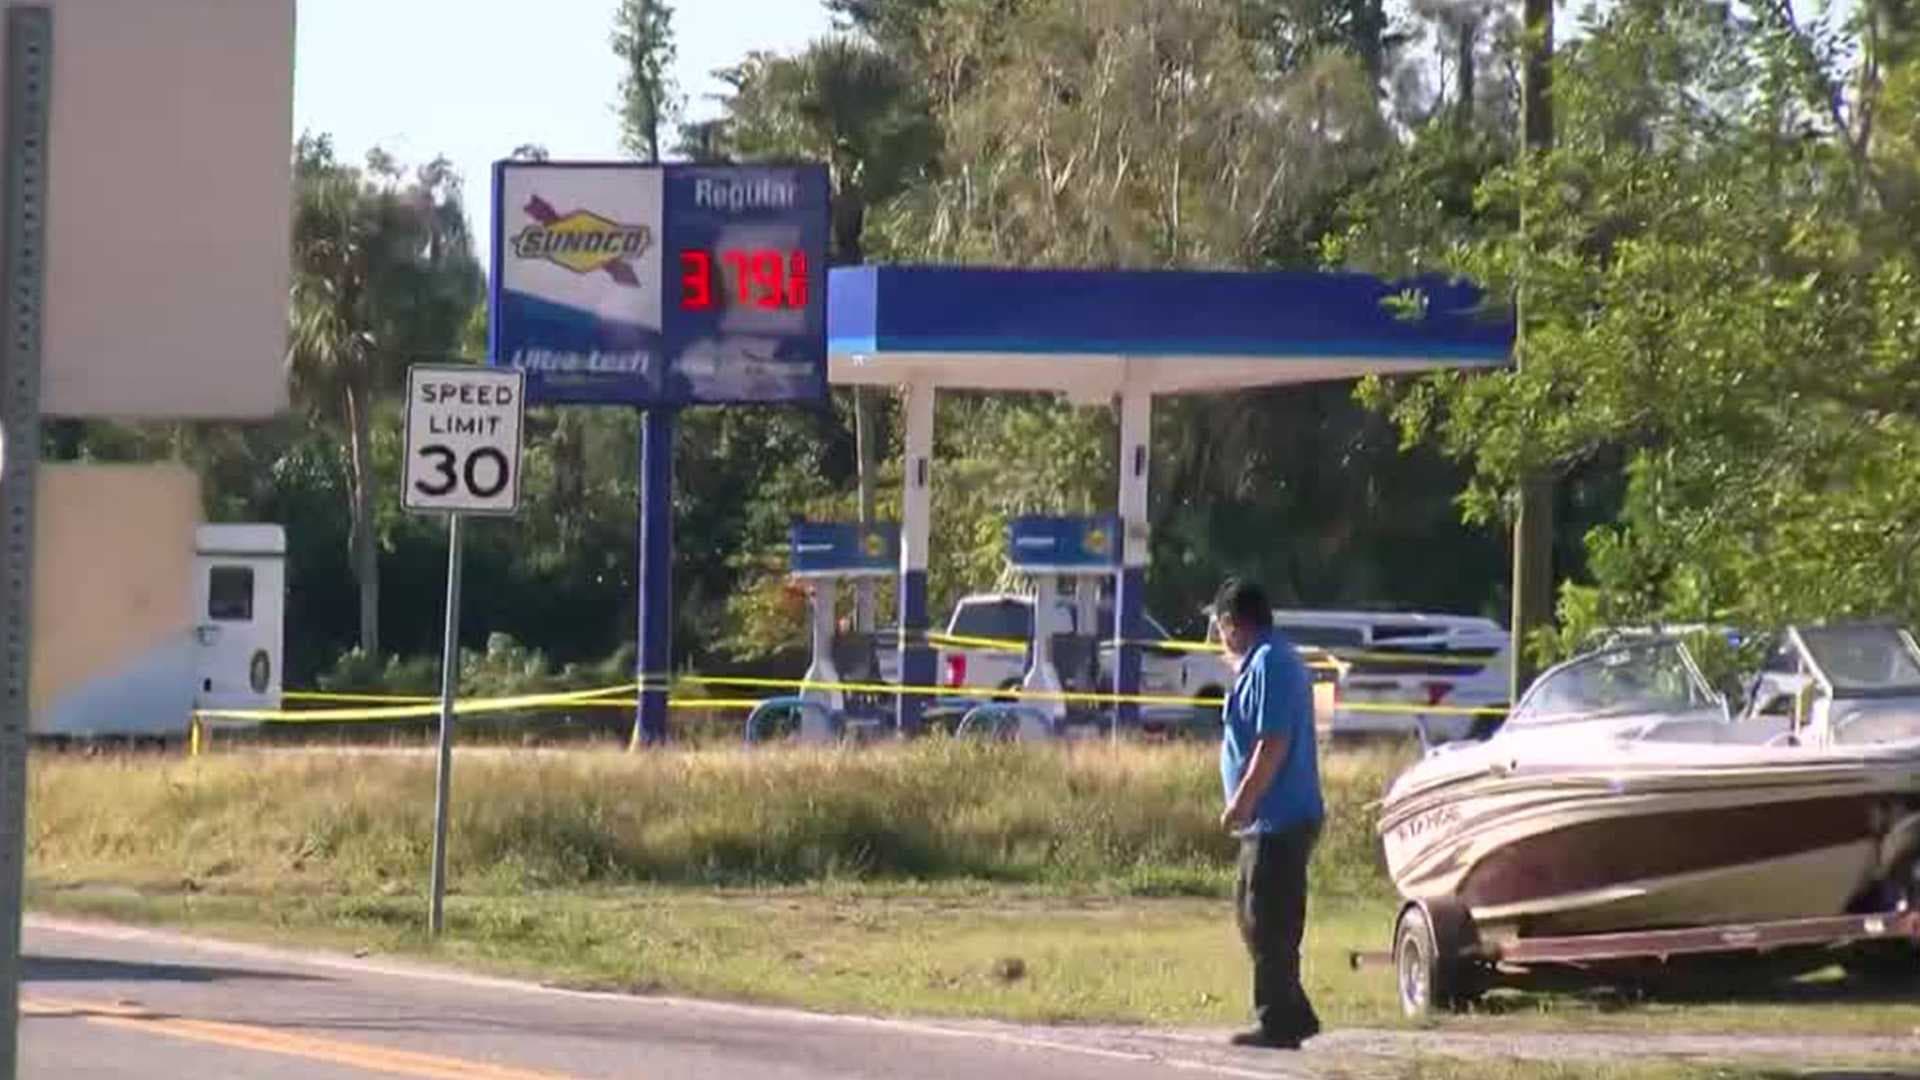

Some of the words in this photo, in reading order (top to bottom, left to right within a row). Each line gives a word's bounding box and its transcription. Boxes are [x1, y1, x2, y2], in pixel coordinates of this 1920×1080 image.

[695, 177, 796, 209] Regular
[520, 229, 643, 254] SUNOCO
[421, 384, 513, 405] SPEED
[430, 415, 502, 435] LIMIT
[415, 445, 510, 498] 30
